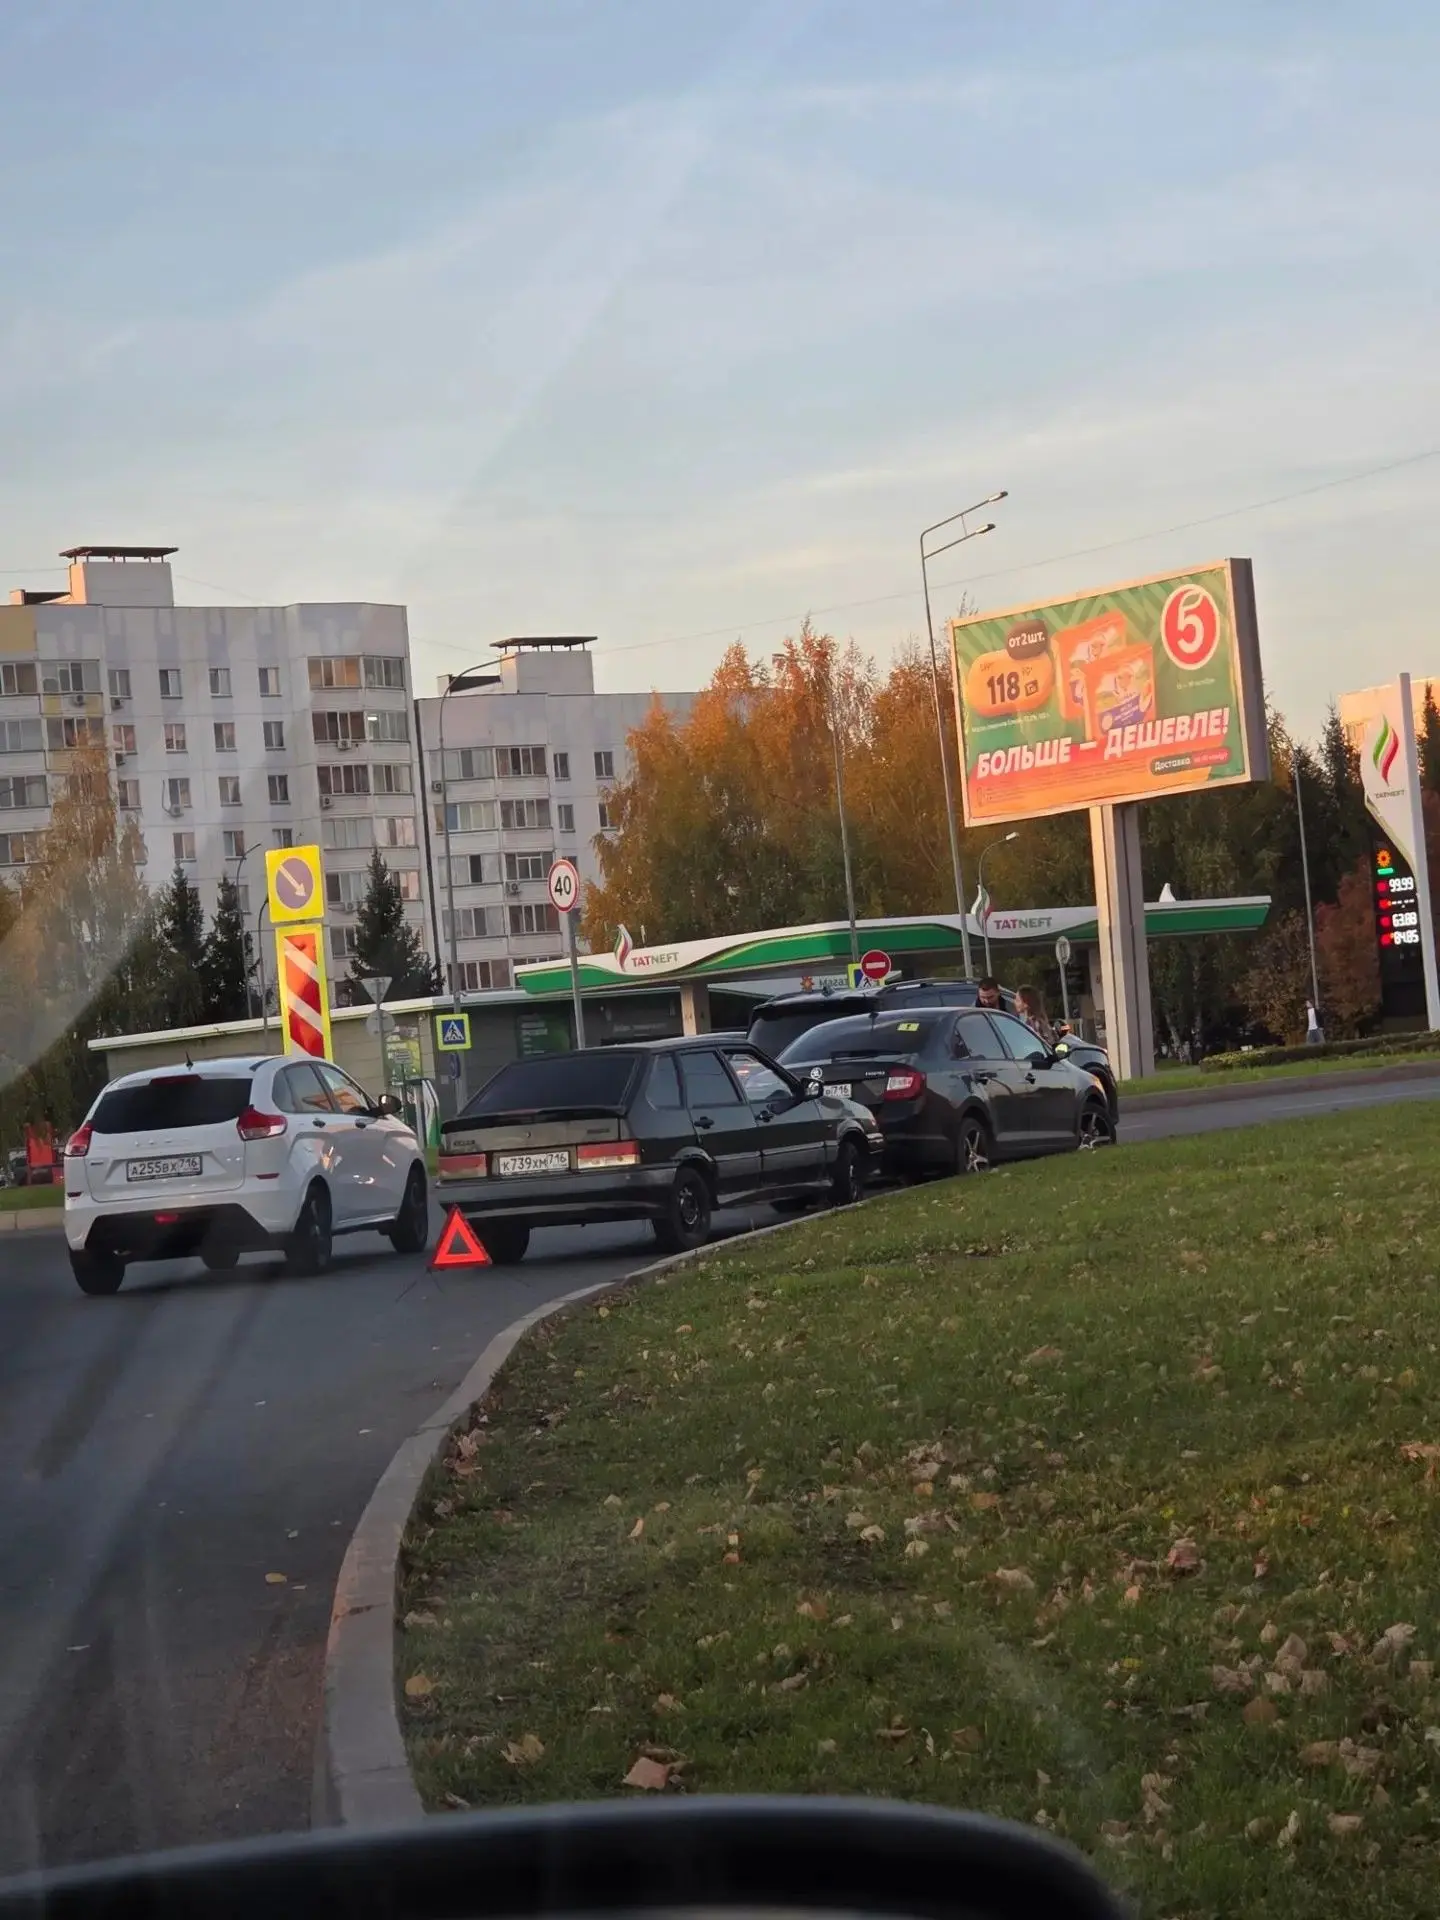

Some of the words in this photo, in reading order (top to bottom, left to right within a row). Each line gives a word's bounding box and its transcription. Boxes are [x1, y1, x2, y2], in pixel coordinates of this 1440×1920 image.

[987, 671, 1020, 704] 118
[976, 737, 1072, 780] БОЛЬШЕ
[1104, 707, 1229, 760] ДЕШЕВЛЕ!
[554, 875, 571, 896] 40
[993, 917, 1052, 930] TATNEFT
[631, 952, 679, 967] TATNEFT
